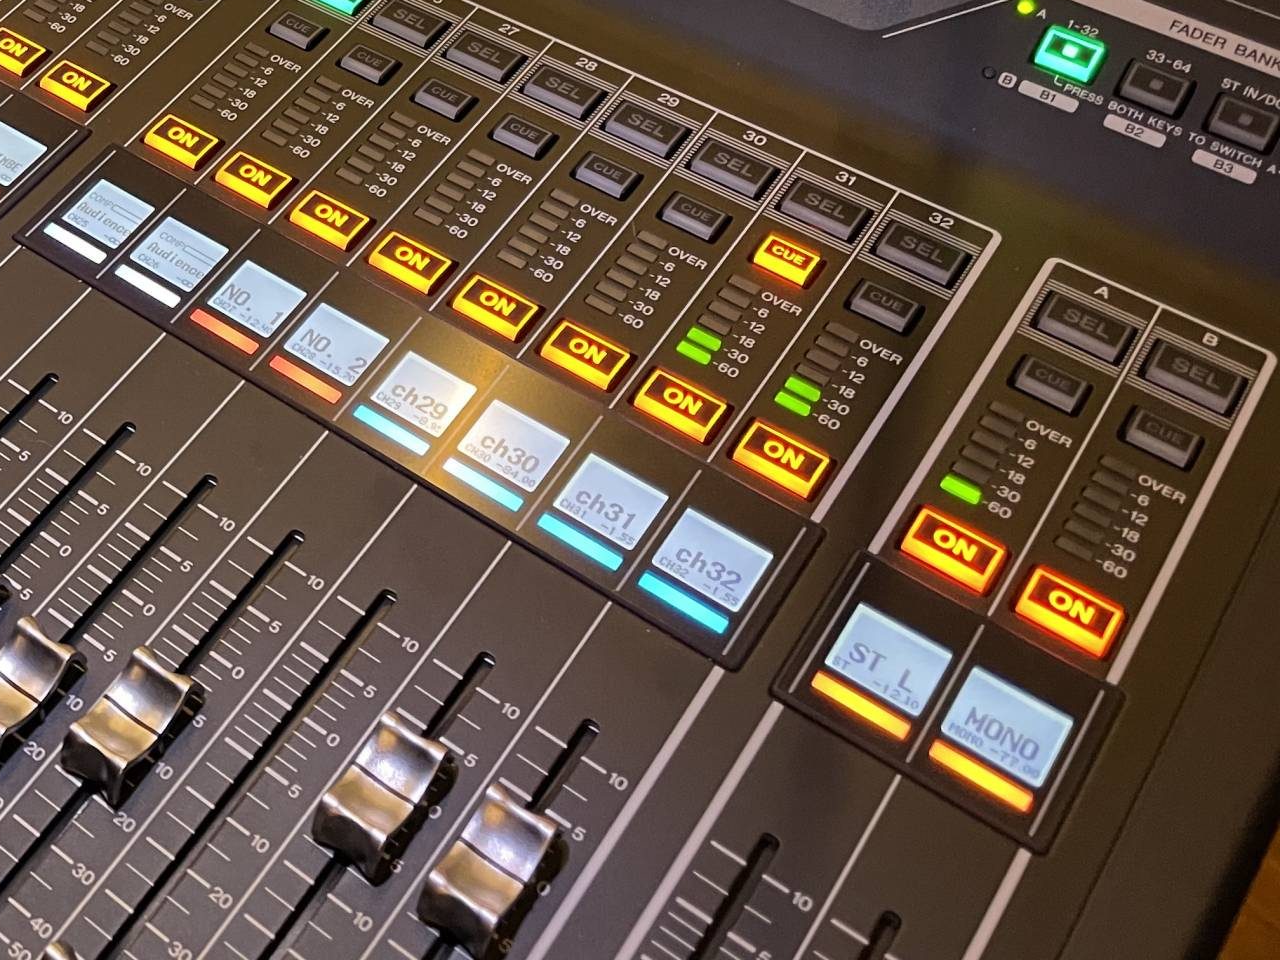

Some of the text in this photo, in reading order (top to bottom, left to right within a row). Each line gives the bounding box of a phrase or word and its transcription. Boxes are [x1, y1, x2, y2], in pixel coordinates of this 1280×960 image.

[392, 8, 426, 30] SEL
[501, 23, 521, 37] 27
[1169, 19, 1280, 71] FADER BANK
[575, 57, 599, 72] 28
[1146, 49, 1193, 73] 33-64
[1039, 89, 1057, 102] B1
[1221, 78, 1241, 92] ST
[657, 92, 680, 108] 29
[168, 126, 199, 147] ON
[1063, 83, 1263, 169] PRESS BOTH KEYS TO SWITCH
[1124, 124, 1145, 138] B2
[742, 131, 767, 147] 30
[1213, 159, 1235, 174] B3
[836, 171, 858, 187] 31
[77, 202, 131, 236] Audience
[929, 212, 955, 229] 32
[770, 243, 806, 267] CUE
[899, 233, 943, 263] SEL
[147, 243, 205, 278] Audience
[221, 284, 251, 311] NO.
[760, 291, 802, 316] OVER
[1095, 286, 1108, 299] A
[300, 329, 367, 372] NO. 2
[1202, 332, 1218, 346] B
[391, 383, 449, 420] ch29
[1025, 420, 1072, 449] OVER
[480, 434, 540, 473] ch30
[762, 437, 805, 470] ON
[1009, 453, 1035, 469] -12
[576, 488, 635, 527] ch31
[982, 501, 1012, 519] -60
[933, 529, 978, 559] ON
[676, 547, 742, 590] ch32
[1048, 590, 1096, 624] ON
[849, 643, 912, 692] ST L
[965, 708, 1040, 760] MONO
[606, 771, 629, 791] 10
